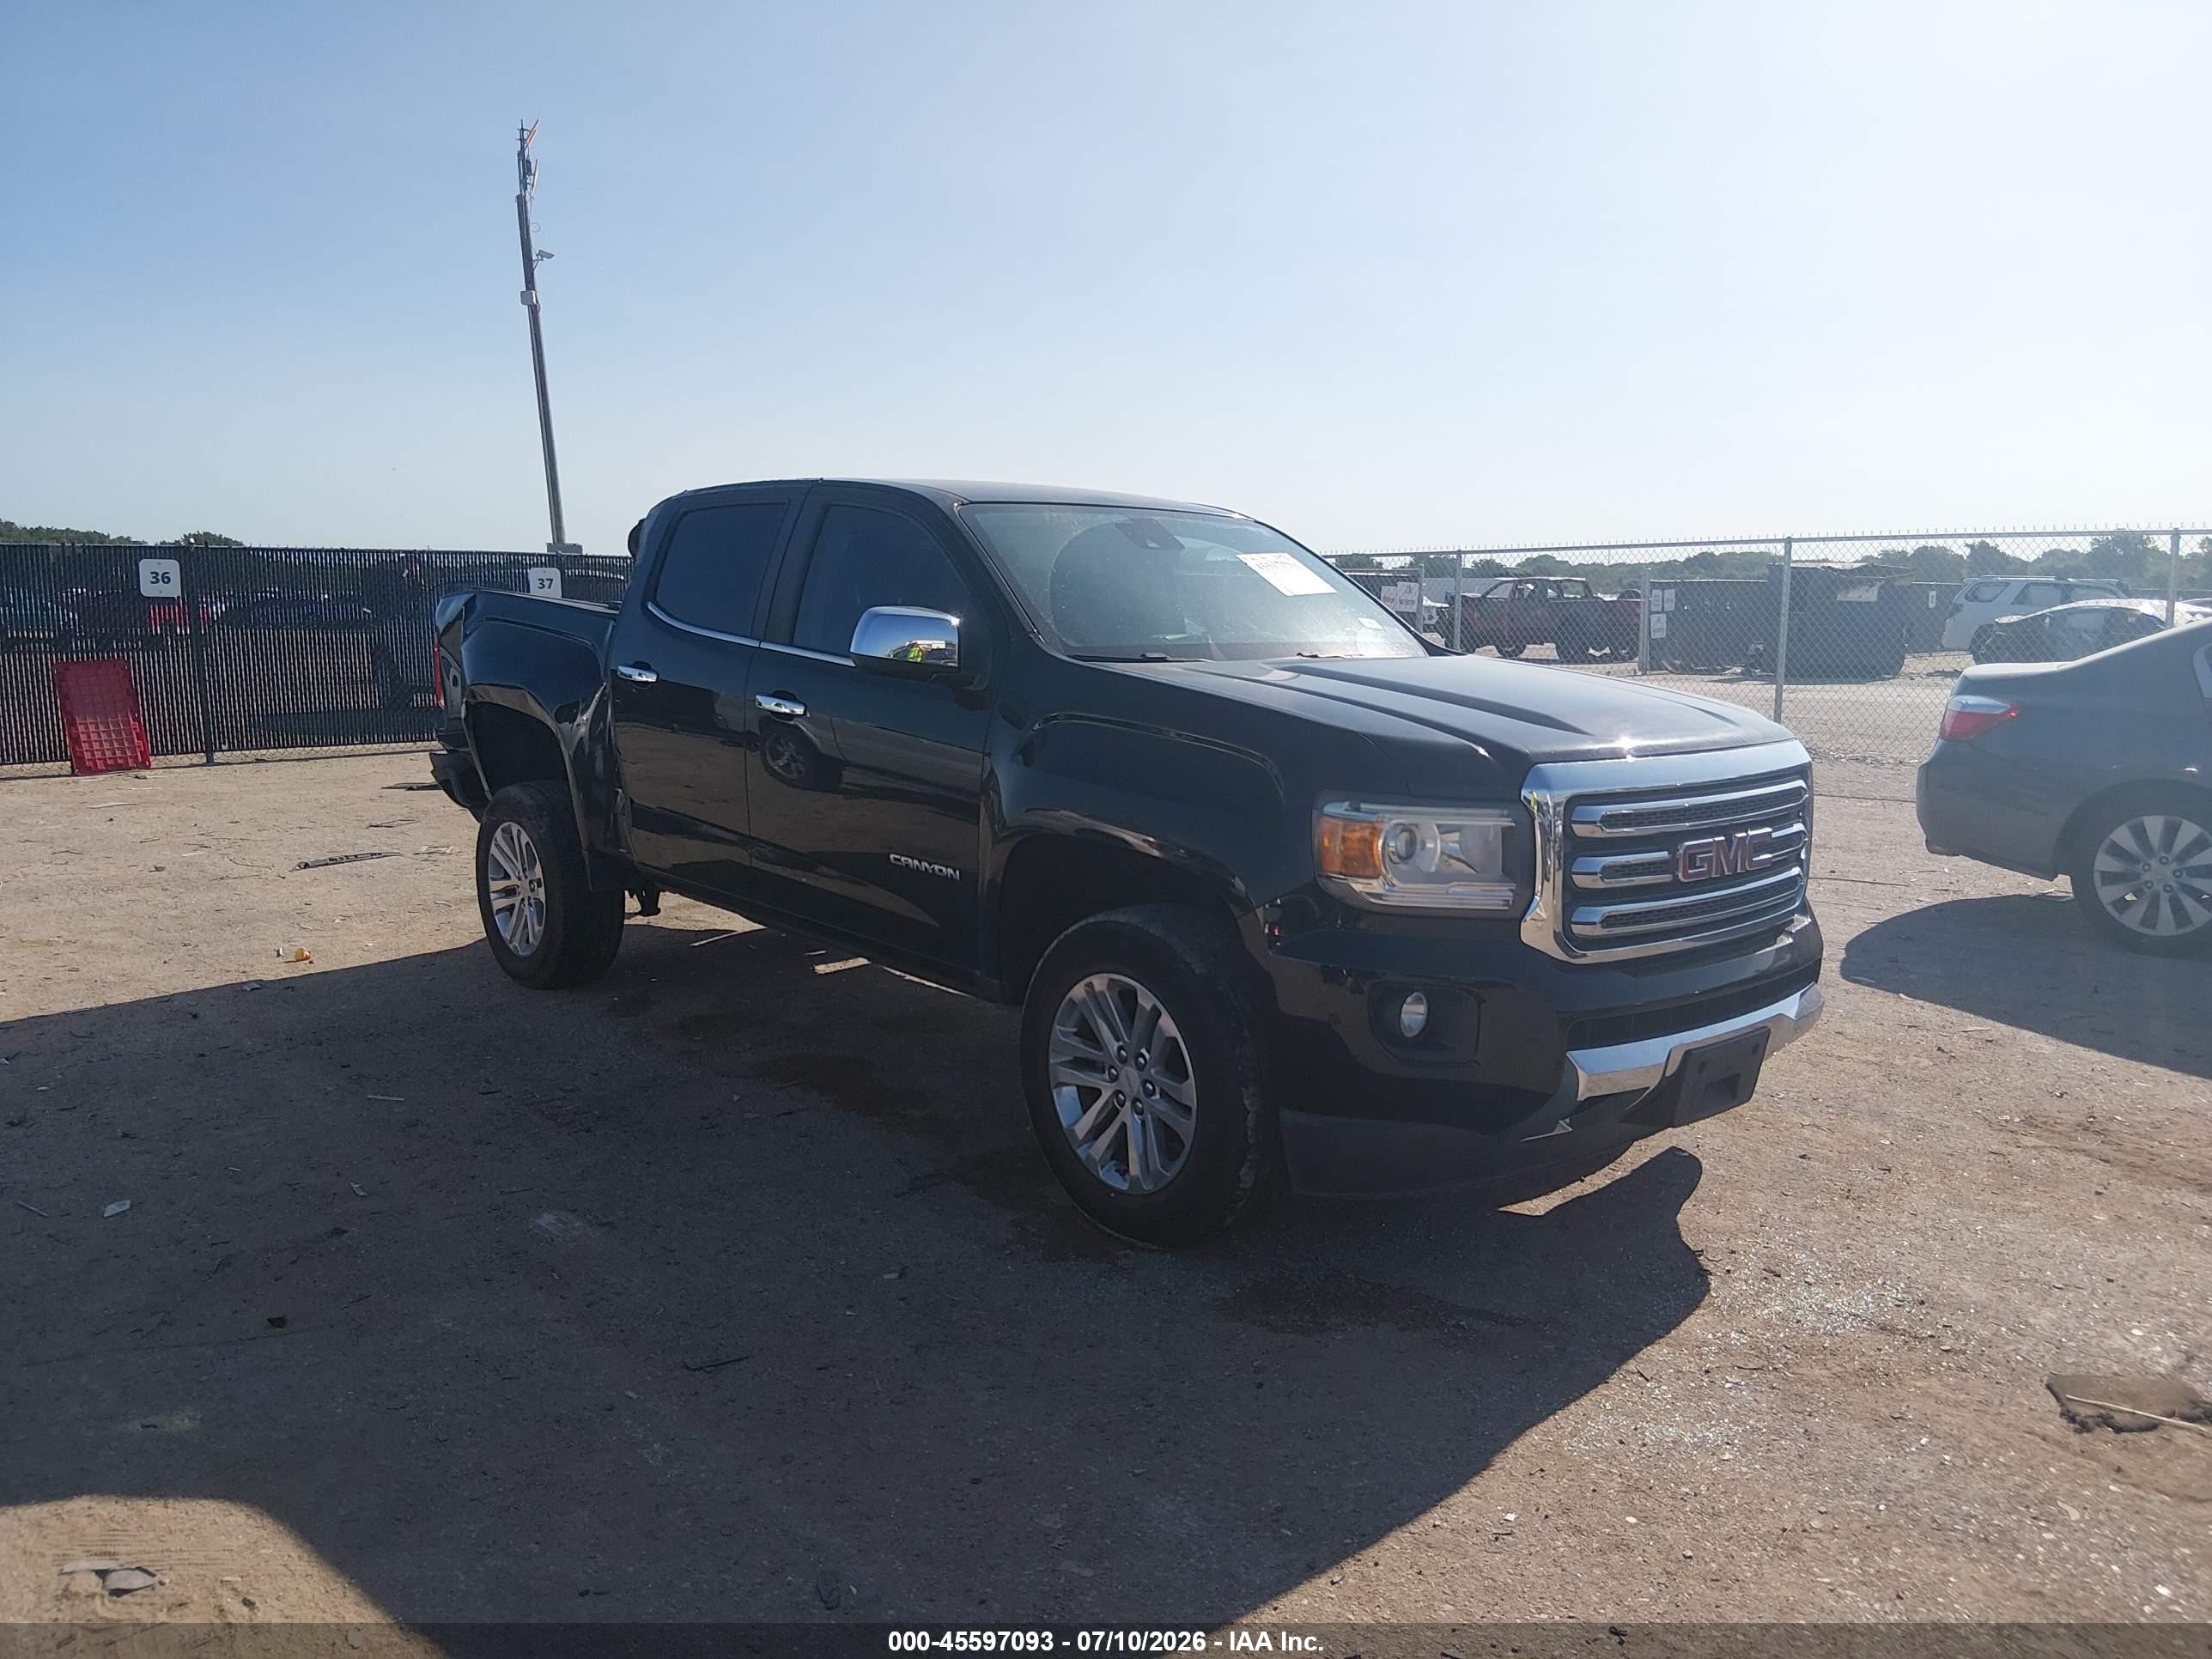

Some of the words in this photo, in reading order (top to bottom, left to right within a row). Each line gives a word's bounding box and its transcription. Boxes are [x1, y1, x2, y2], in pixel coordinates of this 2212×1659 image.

[149, 571, 171, 585] 36
[538, 578, 554, 590] 37
[1678, 827, 1773, 883] GMC
[889, 853, 961, 881] CANYON
